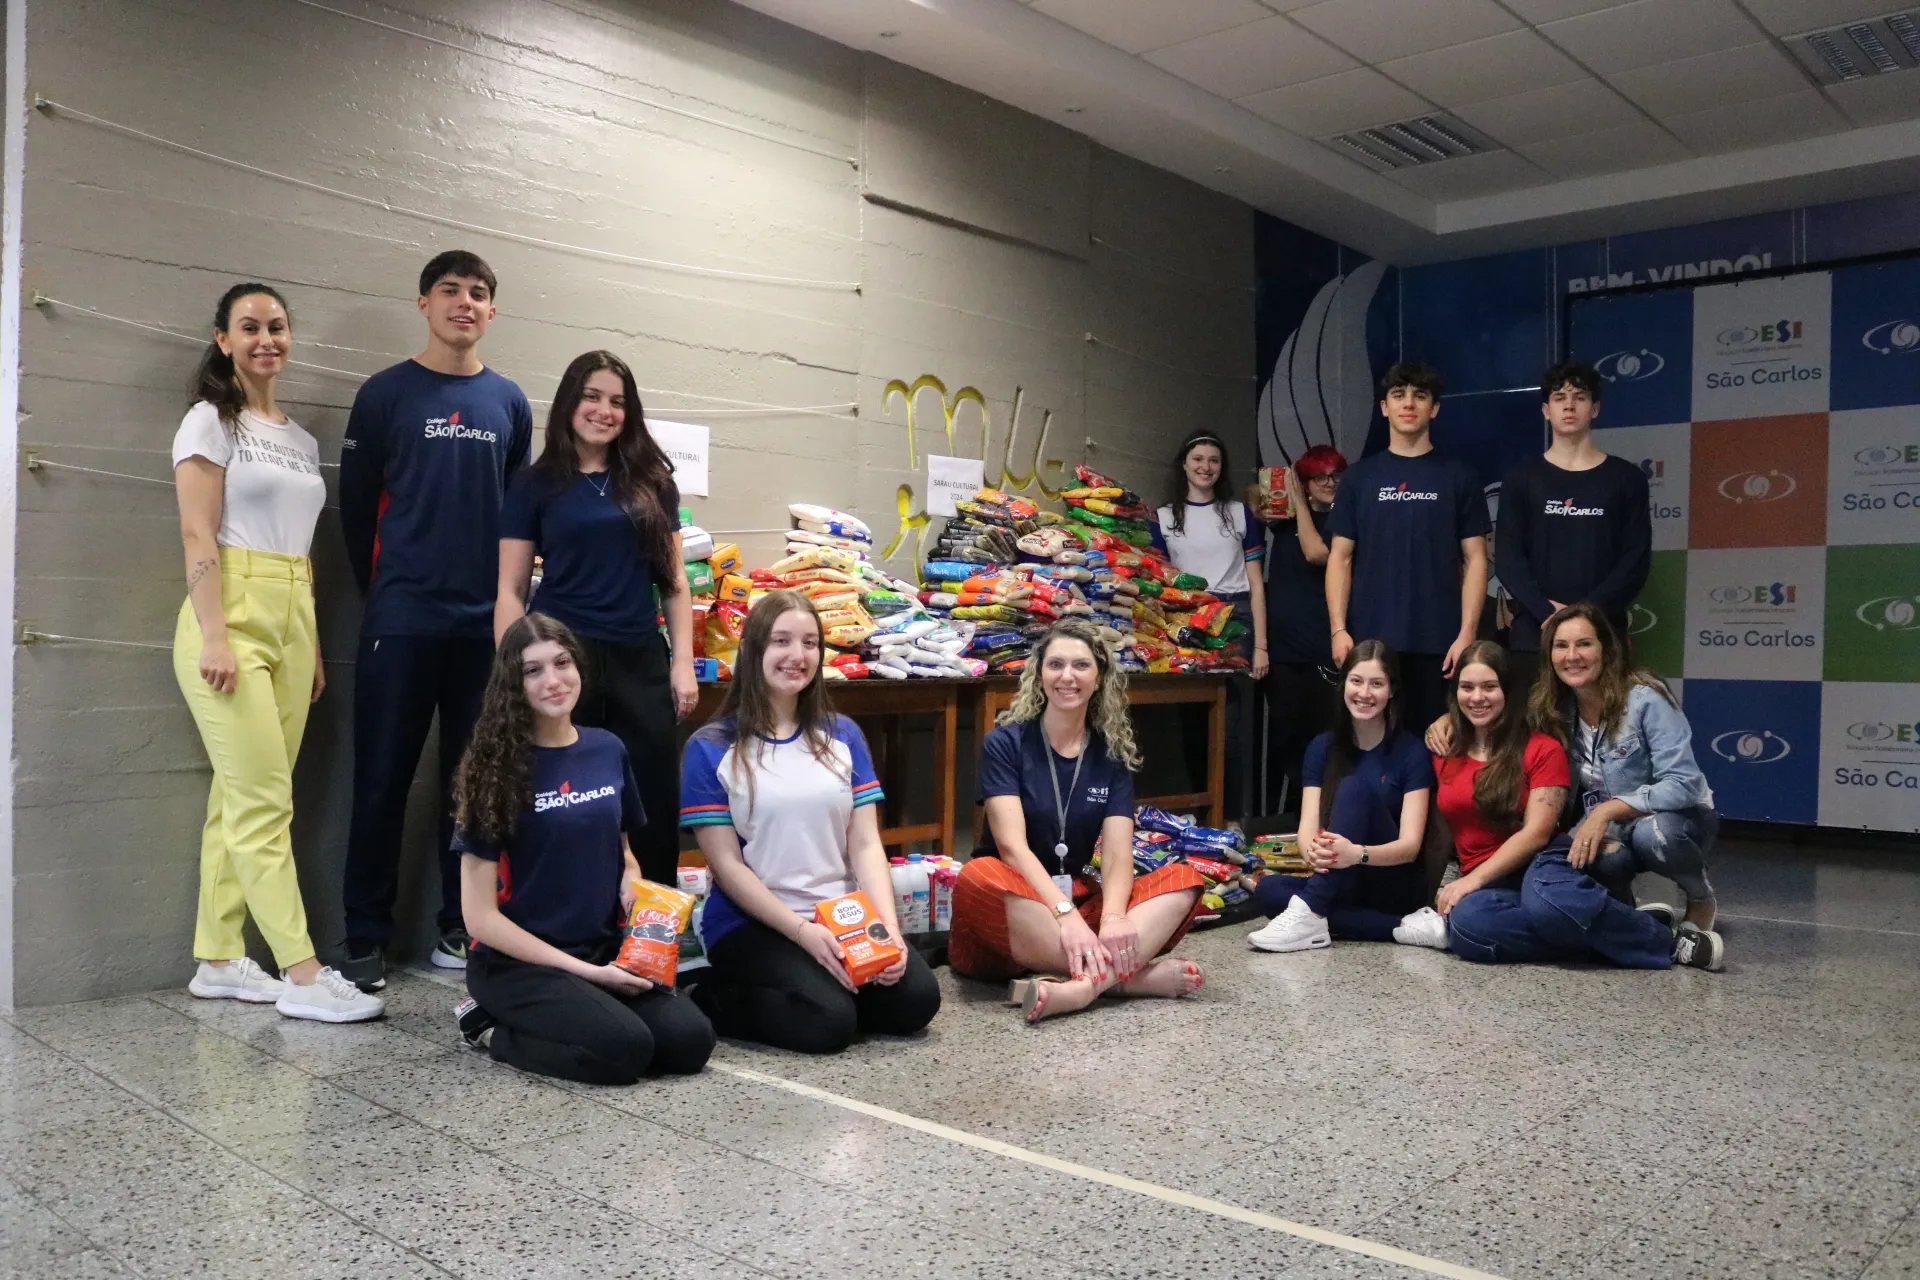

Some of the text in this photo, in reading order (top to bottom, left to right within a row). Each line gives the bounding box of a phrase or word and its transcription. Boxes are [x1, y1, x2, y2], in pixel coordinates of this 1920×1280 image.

[1761, 319, 1802, 343] ESI
[1706, 364, 1822, 389] São Carlos
[251, 436, 260, 448] A
[424, 425, 497, 443] SÃO CARLOS
[238, 449, 253, 463] TO
[255, 451, 286, 468] LEAVE
[287, 459, 303, 473] ME
[952, 481, 979, 491] CULTURAL
[1378, 491, 1438, 501] SÃO CARLOS
[1843, 493, 1886, 511] São
[1544, 504, 1604, 516] SÃO CARLOS
[1754, 582, 1796, 606] ESI
[1699, 629, 1816, 647] São Carlos
[1835, 767, 1878, 787] São
[534, 786, 616, 812] SÃO CARLOS
[837, 904, 857, 914] BOM
[838, 908, 862, 920] JESUS
[846, 941, 871, 952] TUDO
